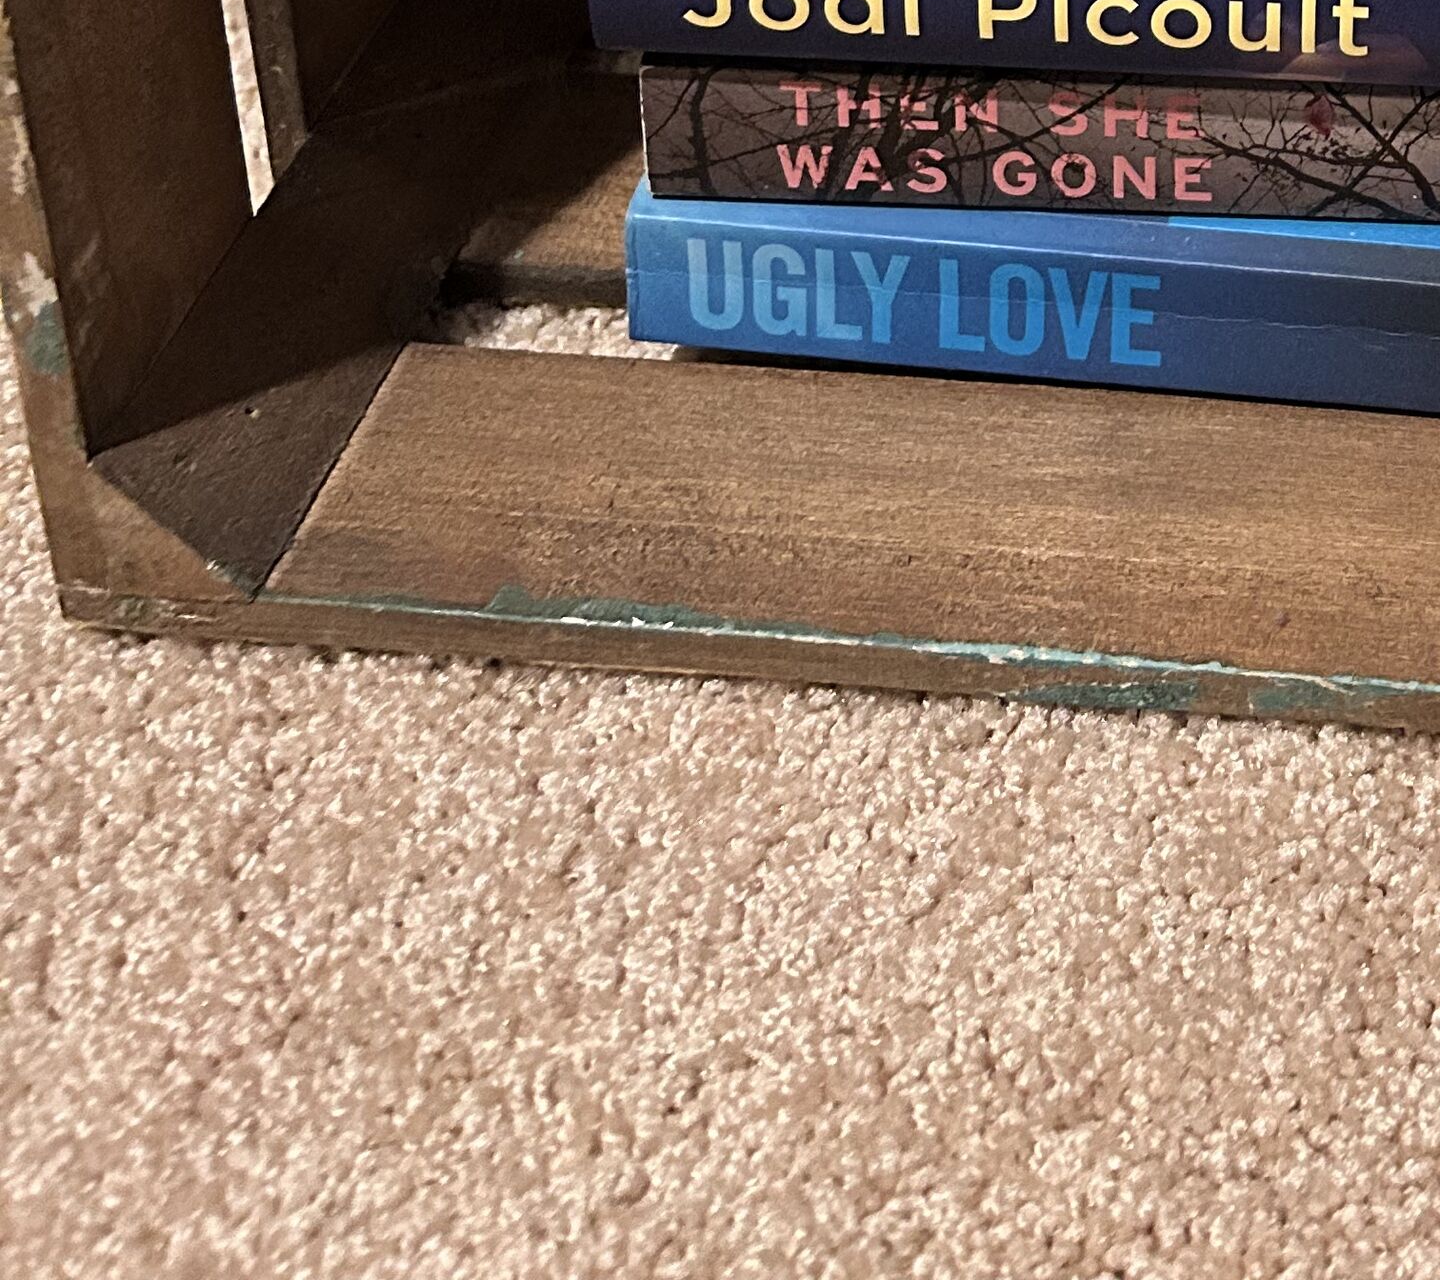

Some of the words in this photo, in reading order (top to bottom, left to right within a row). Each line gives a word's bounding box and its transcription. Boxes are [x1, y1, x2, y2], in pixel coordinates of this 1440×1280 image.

[780, 81, 998, 135] THEN
[1047, 89, 1207, 140] SHE
[777, 144, 948, 195] WAS
[992, 150, 1213, 203] GONE
[686, 237, 909, 344] UGLY
[938, 258, 1162, 368] LOVE
